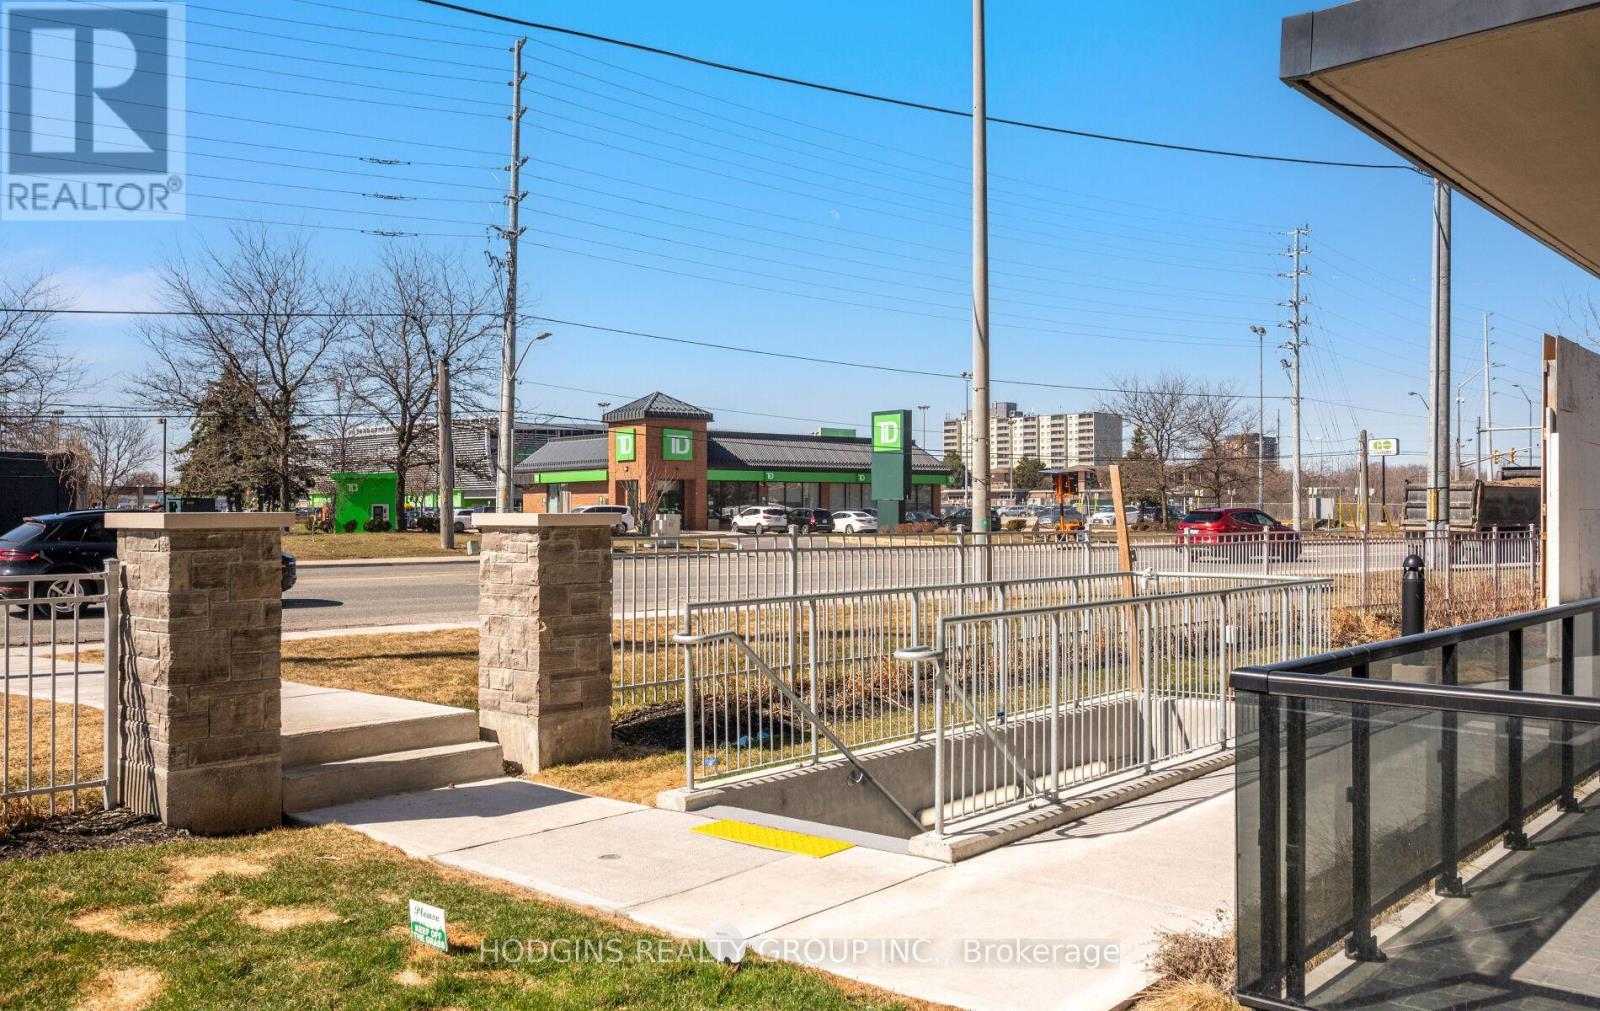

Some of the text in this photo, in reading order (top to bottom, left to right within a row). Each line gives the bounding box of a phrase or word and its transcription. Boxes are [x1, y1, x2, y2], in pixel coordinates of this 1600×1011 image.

[877, 421, 898, 444] TD
[618, 435, 635, 455] TD
[667, 434, 690, 455] TD
[767, 472, 775, 480] TD
[346, 483, 358, 492] TD
[413, 904, 441, 922] Please
[413, 931, 426, 943] THE
[414, 923, 442, 941] KEEP OFF
